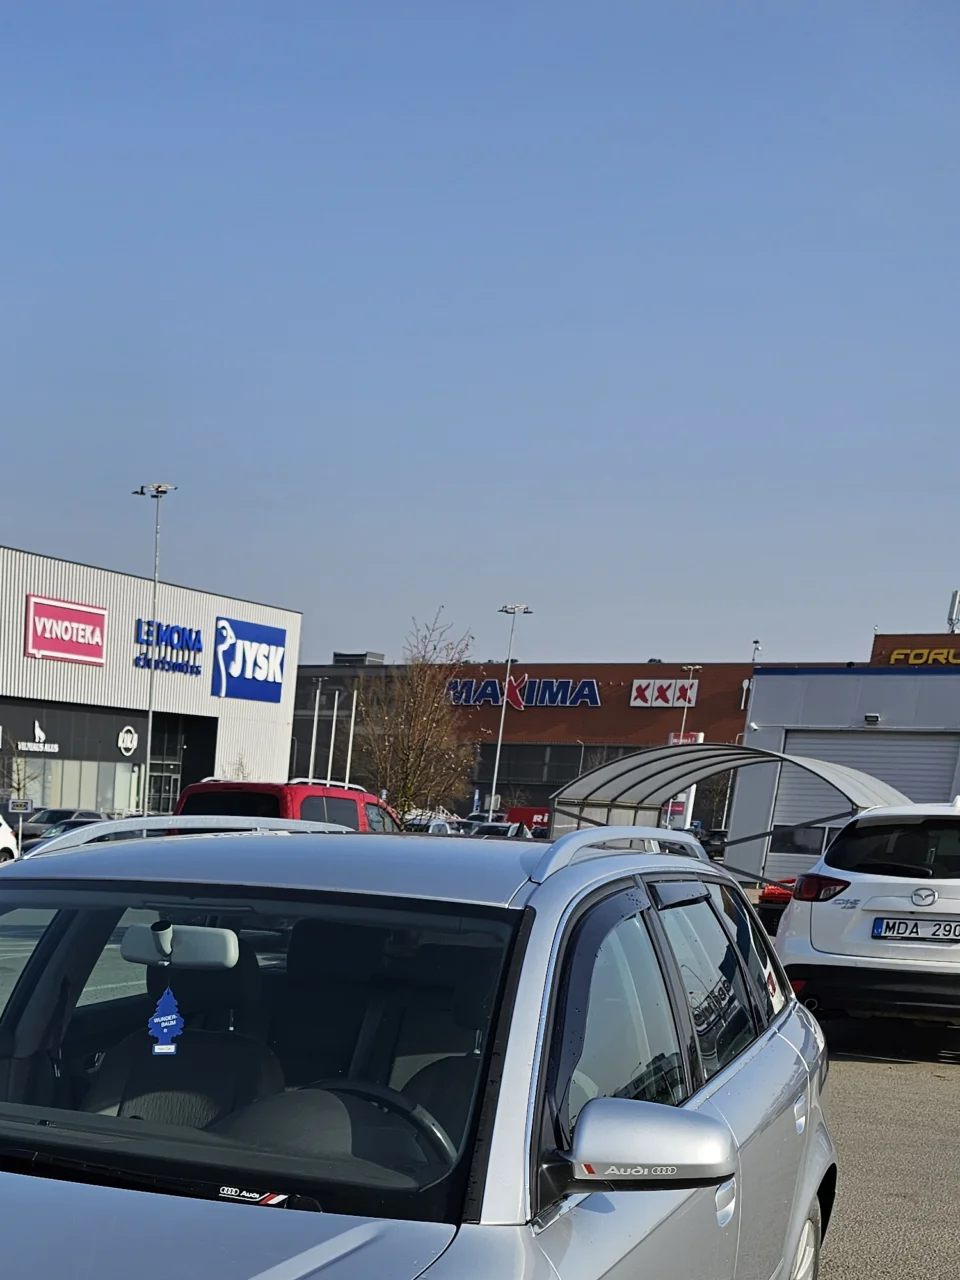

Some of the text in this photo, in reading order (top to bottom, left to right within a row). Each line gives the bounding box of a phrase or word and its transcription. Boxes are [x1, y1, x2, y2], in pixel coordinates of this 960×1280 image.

[34, 616, 102, 646] VYNOTEKA
[137, 618, 203, 652] LEMONA
[229, 639, 284, 683] JYSK
[445, 673, 601, 711] MAXIMA
[883, 921, 920, 936] MDA
[931, 923, 960, 937] 290
[604, 1165, 648, 1176] Audi
[240, 1190, 260, 1199] Audi
